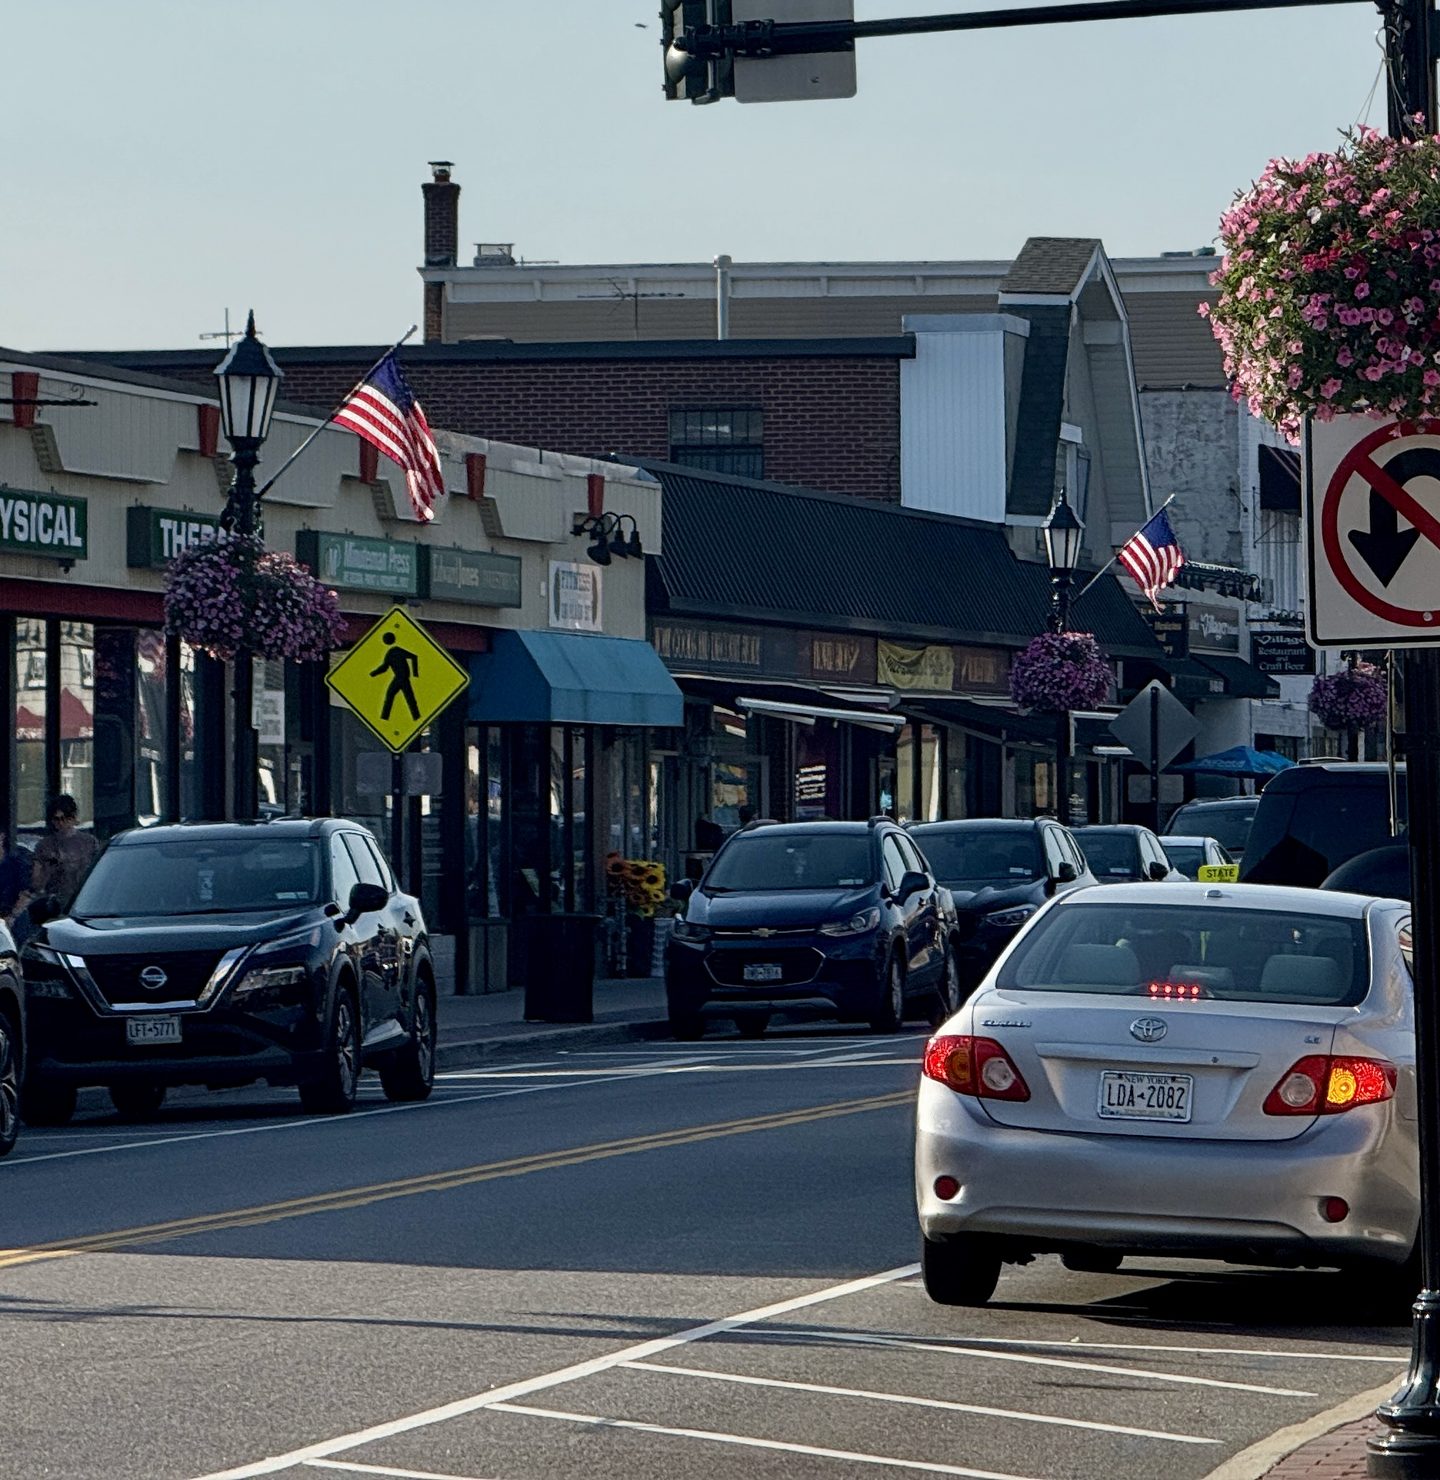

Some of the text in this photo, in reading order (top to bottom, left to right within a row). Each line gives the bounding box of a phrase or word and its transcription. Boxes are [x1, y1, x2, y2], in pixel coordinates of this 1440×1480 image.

[389, 545, 410, 574] Press
[1259, 634, 1305, 645] Village
[1258, 646, 1307, 656] Restaurant
[1259, 661, 1306, 671] Craft Beer
[1206, 868, 1235, 878] STATE
[129, 1022, 175, 1037] LFT 5771
[1124, 1075, 1170, 1085] NEW YORK
[1107, 1083, 1185, 1110] LDA 2082
